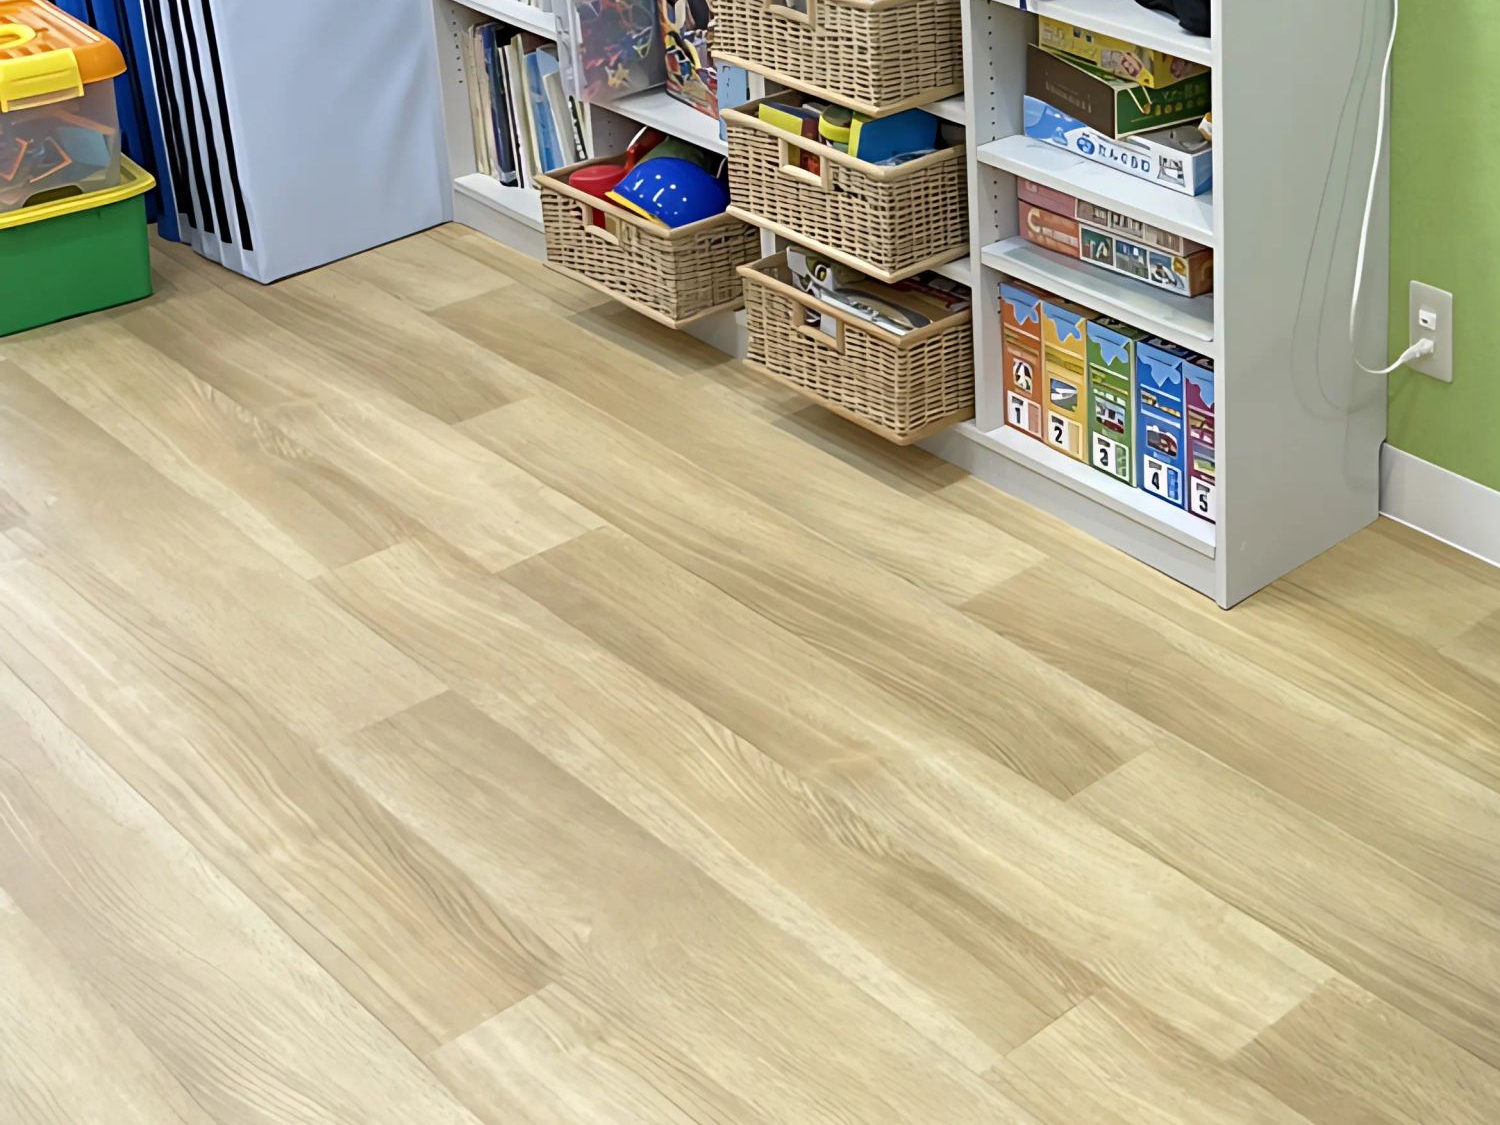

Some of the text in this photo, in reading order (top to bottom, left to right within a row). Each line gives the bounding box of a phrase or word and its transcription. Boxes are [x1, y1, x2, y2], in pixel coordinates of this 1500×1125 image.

[1014, 407, 1021, 424] 1
[1054, 425, 1063, 444] 2
[1151, 472, 1160, 490] 4
[1199, 493, 1208, 512] 5
